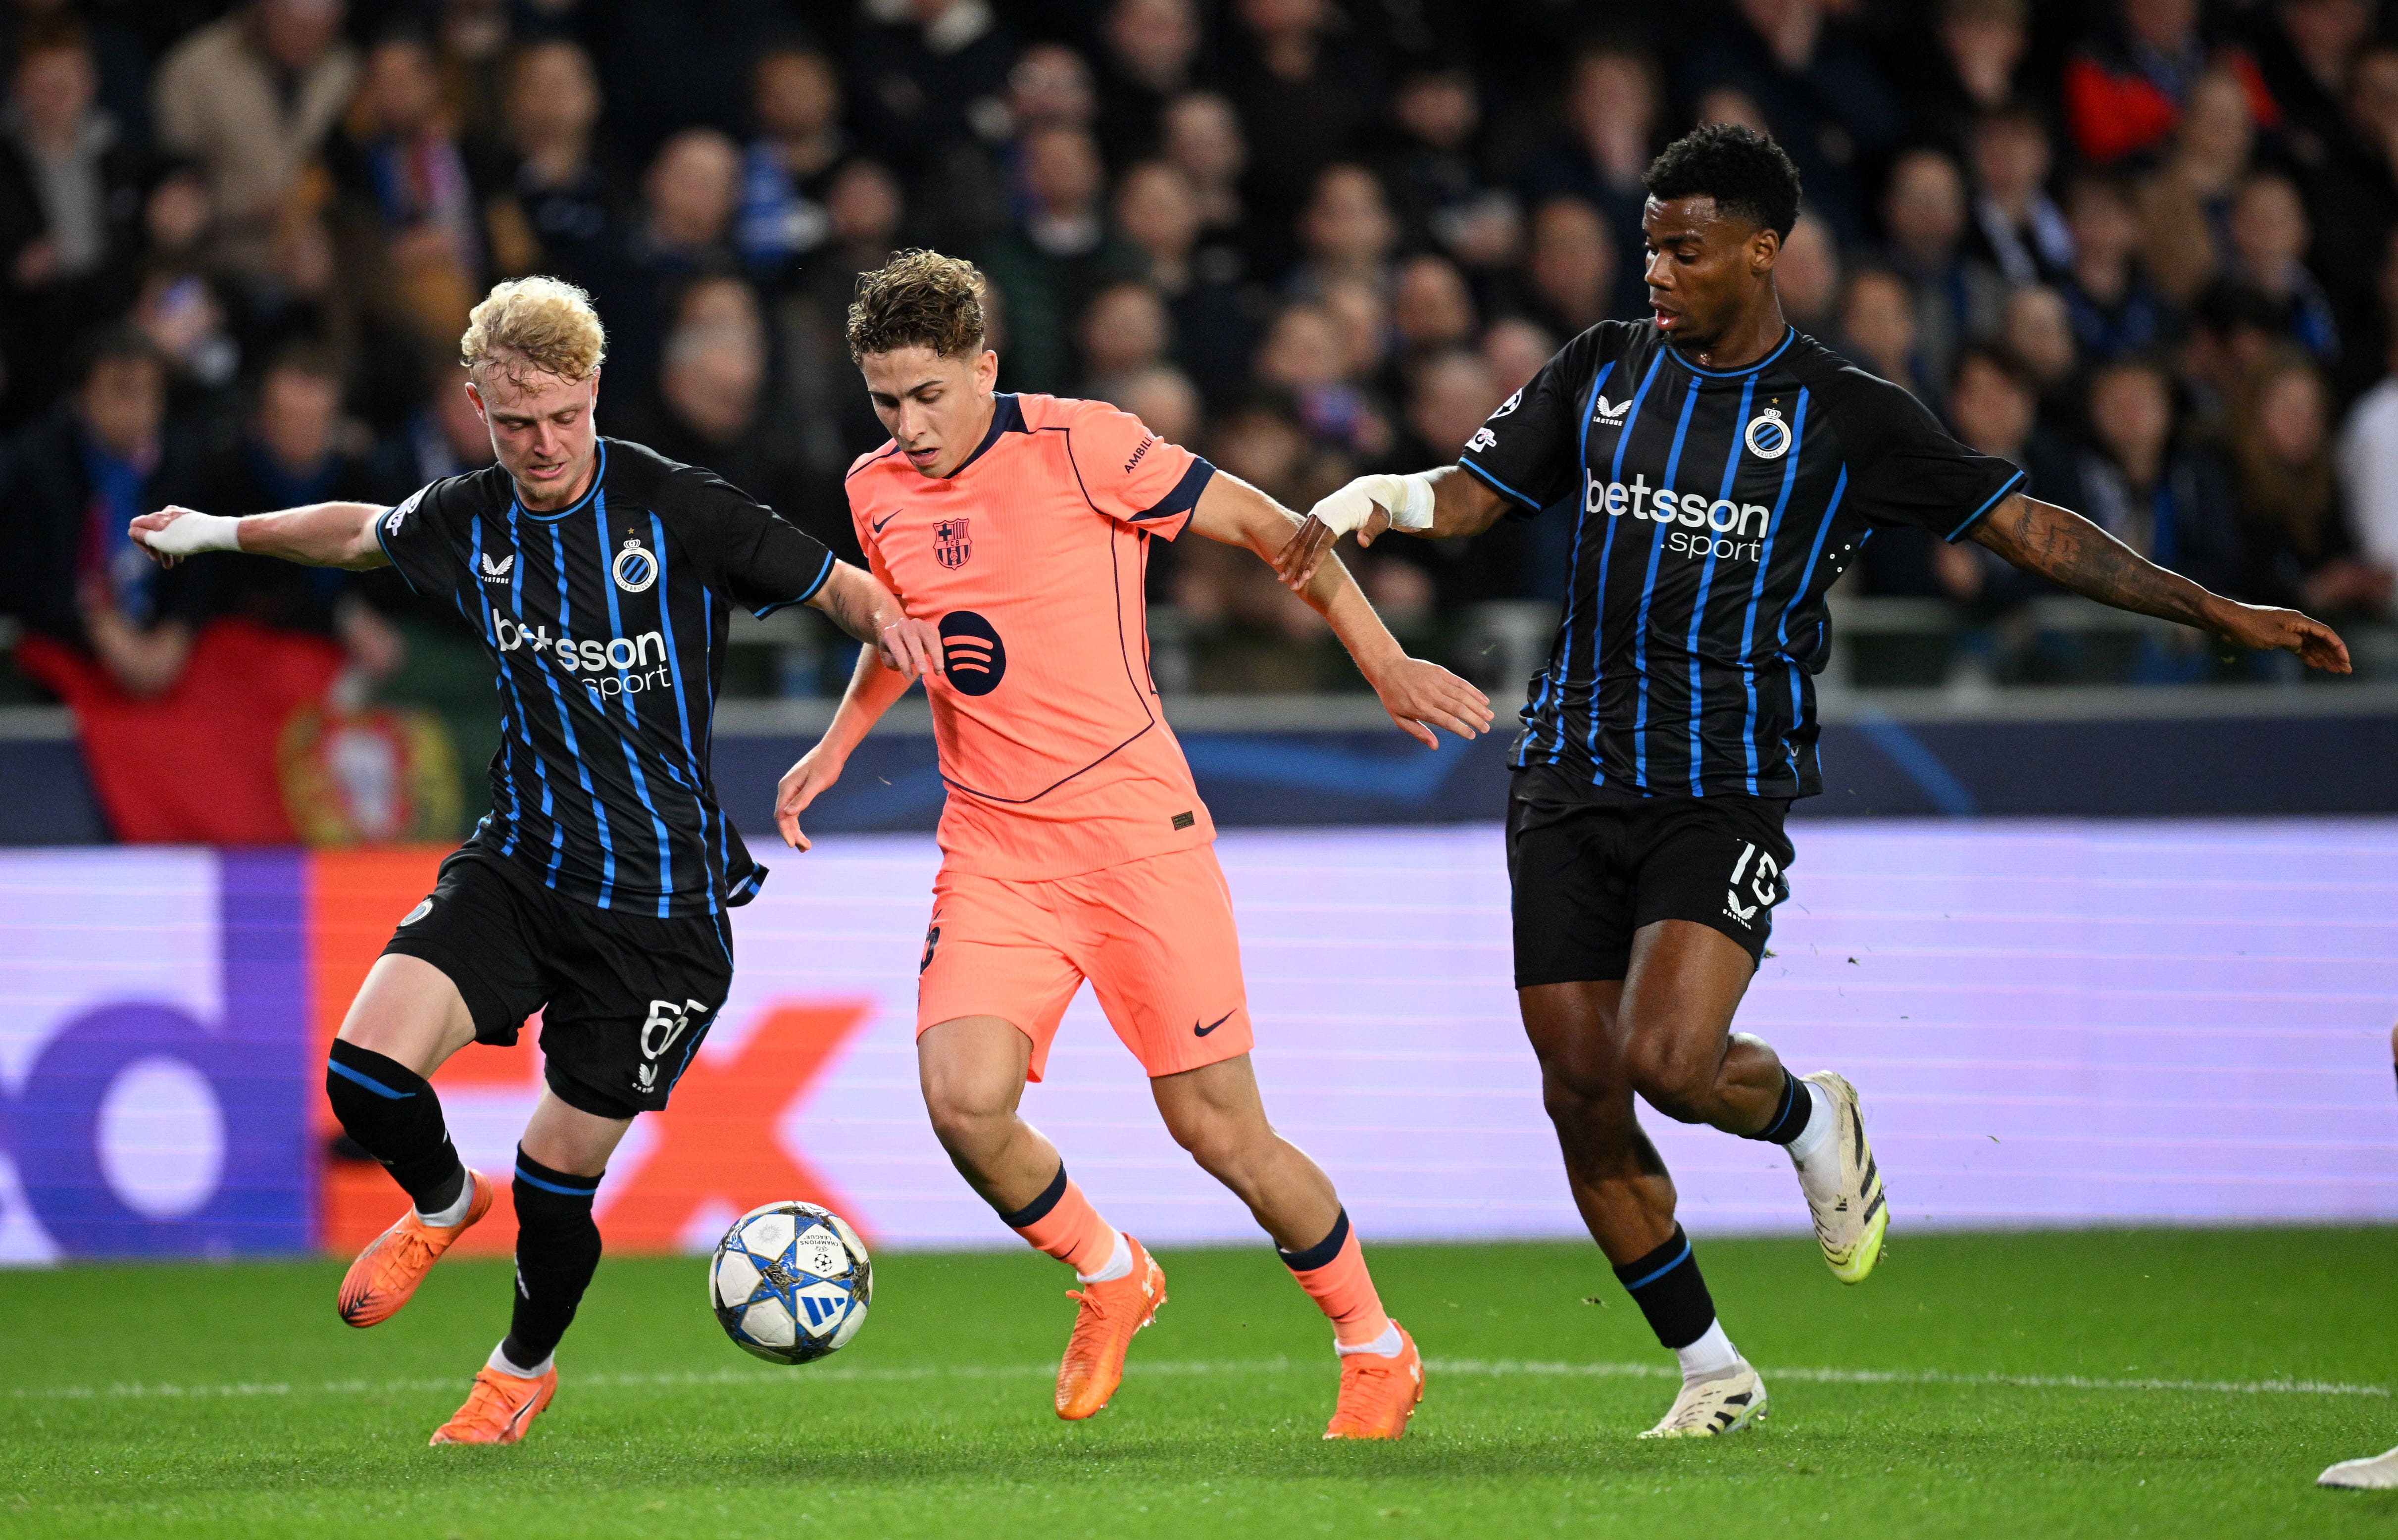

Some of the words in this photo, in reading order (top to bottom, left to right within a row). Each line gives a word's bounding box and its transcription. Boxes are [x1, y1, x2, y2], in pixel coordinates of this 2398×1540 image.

[1586, 468, 1770, 539] betsson
[481, 576, 509, 584] ASTORE
[616, 577, 628, 589] CLUB
[629, 580, 650, 591] BRUGGE
